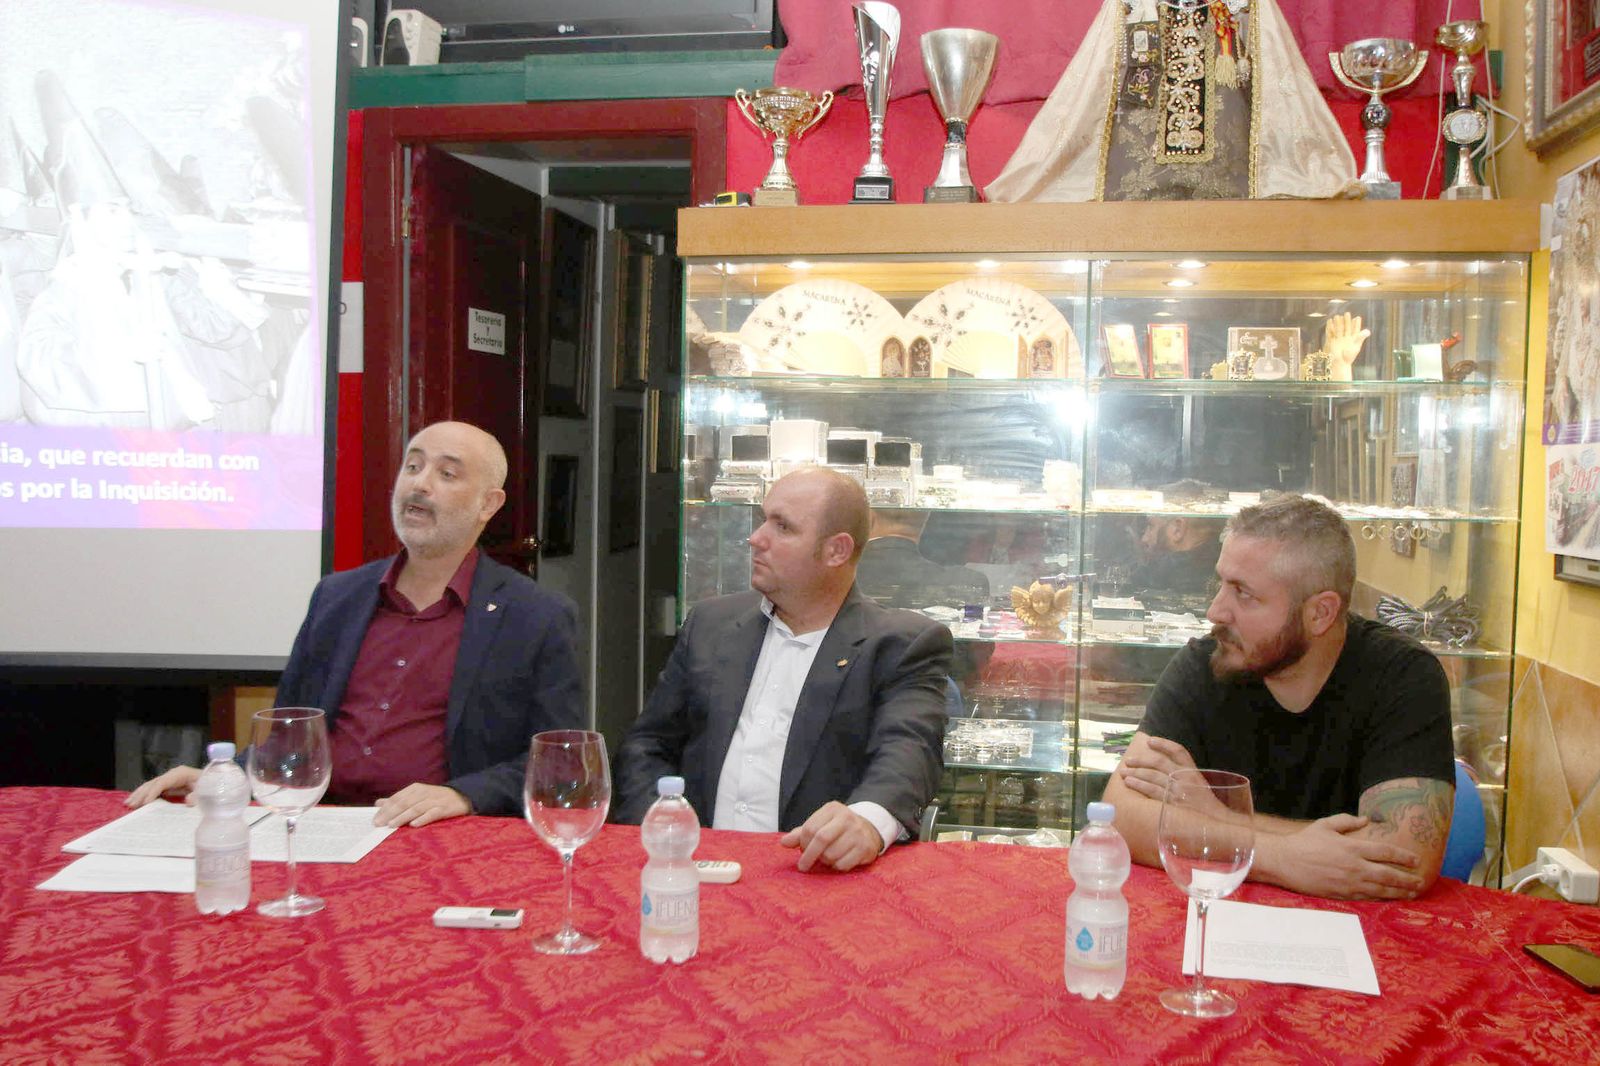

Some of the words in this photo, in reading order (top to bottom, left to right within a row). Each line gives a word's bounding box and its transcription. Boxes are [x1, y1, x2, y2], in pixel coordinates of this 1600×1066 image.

[802, 289, 847, 305] MACARENA
[966, 288, 1011, 305] MACARENA
[0, 442, 32, 468] ia,
[39, 448, 86, 469] que
[92, 448, 213, 470] recuerdan
[218, 452, 260, 471] con
[0, 481, 14, 498] s
[21, 481, 65, 503] por
[70, 478, 93, 499] la
[99, 479, 234, 504] Inquisición.
